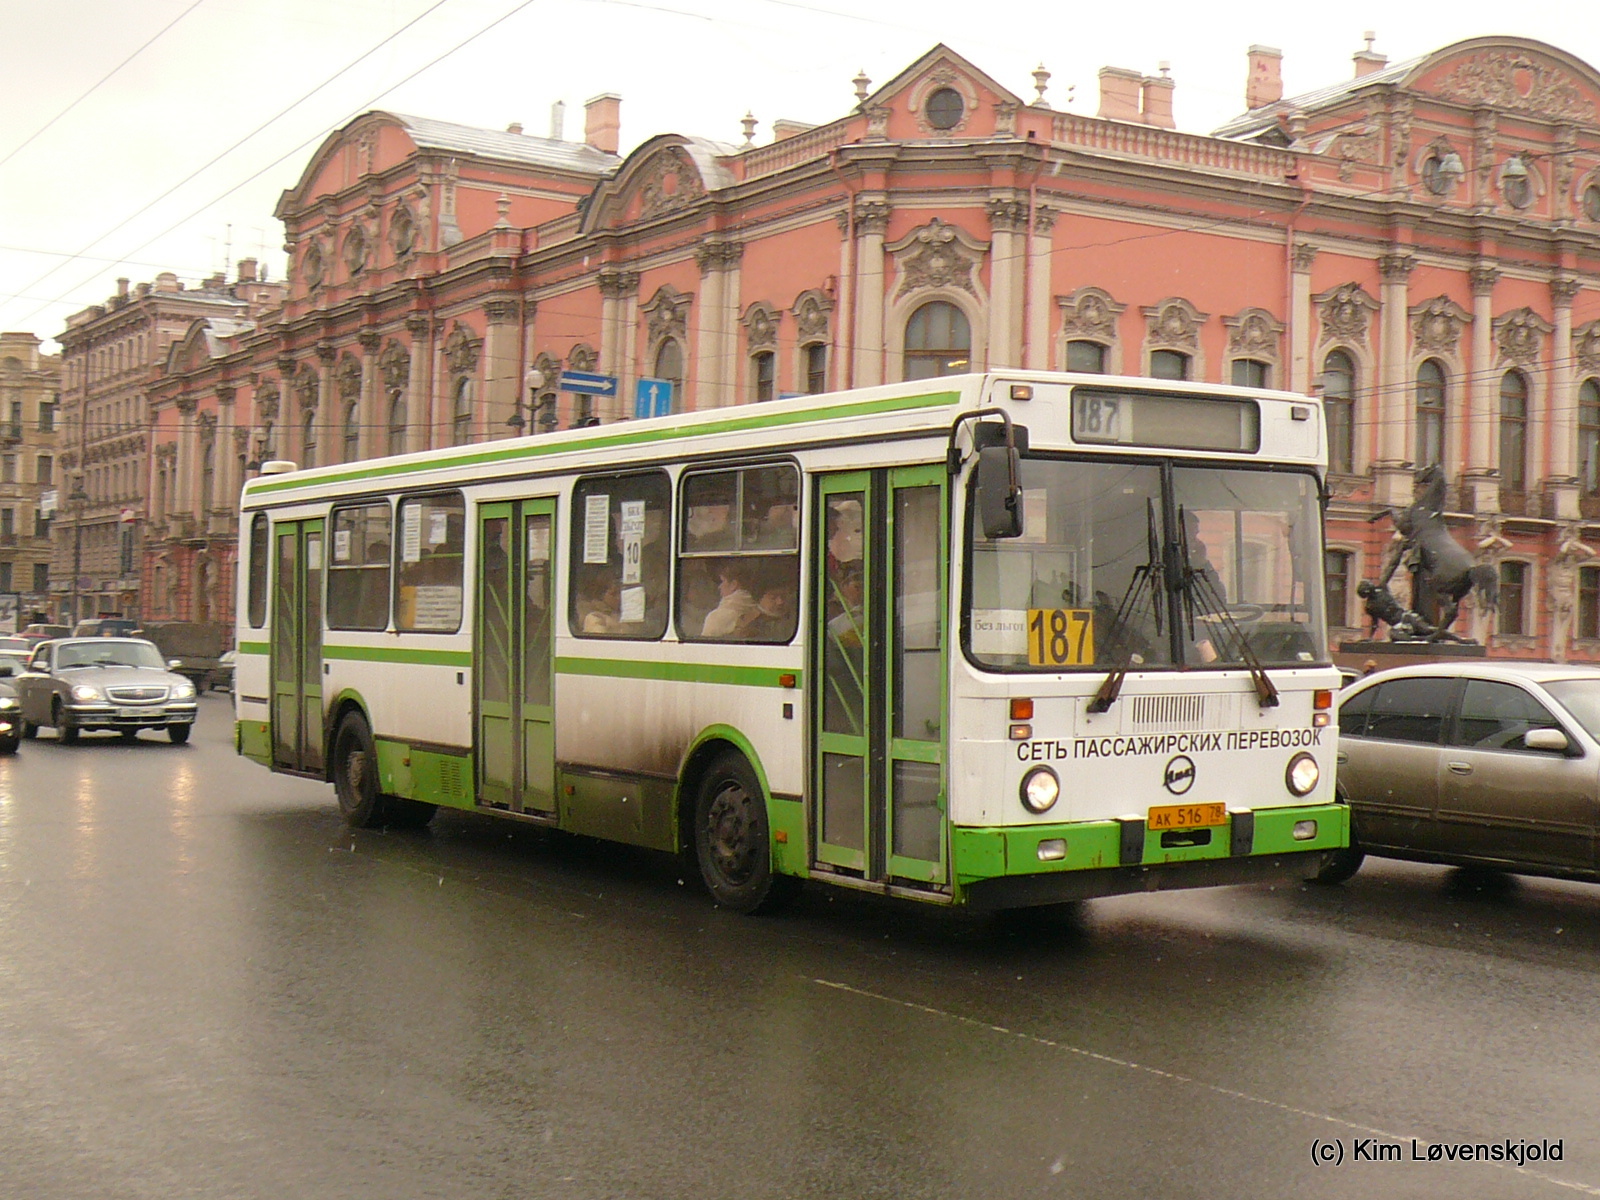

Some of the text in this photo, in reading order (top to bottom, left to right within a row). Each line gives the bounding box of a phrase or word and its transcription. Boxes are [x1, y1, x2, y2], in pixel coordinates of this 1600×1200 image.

[1079, 398, 1117, 433] 187
[627, 542, 639, 564] 10
[975, 619, 993, 631] без
[1031, 609, 1090, 664] 187
[1017, 728, 1322, 761] СЕТЬ ПАССАЖИРСКИХ ПЕРЕВОЗОК
[1177, 808, 1202, 825] 516
[1209, 806, 1222, 818] 78
